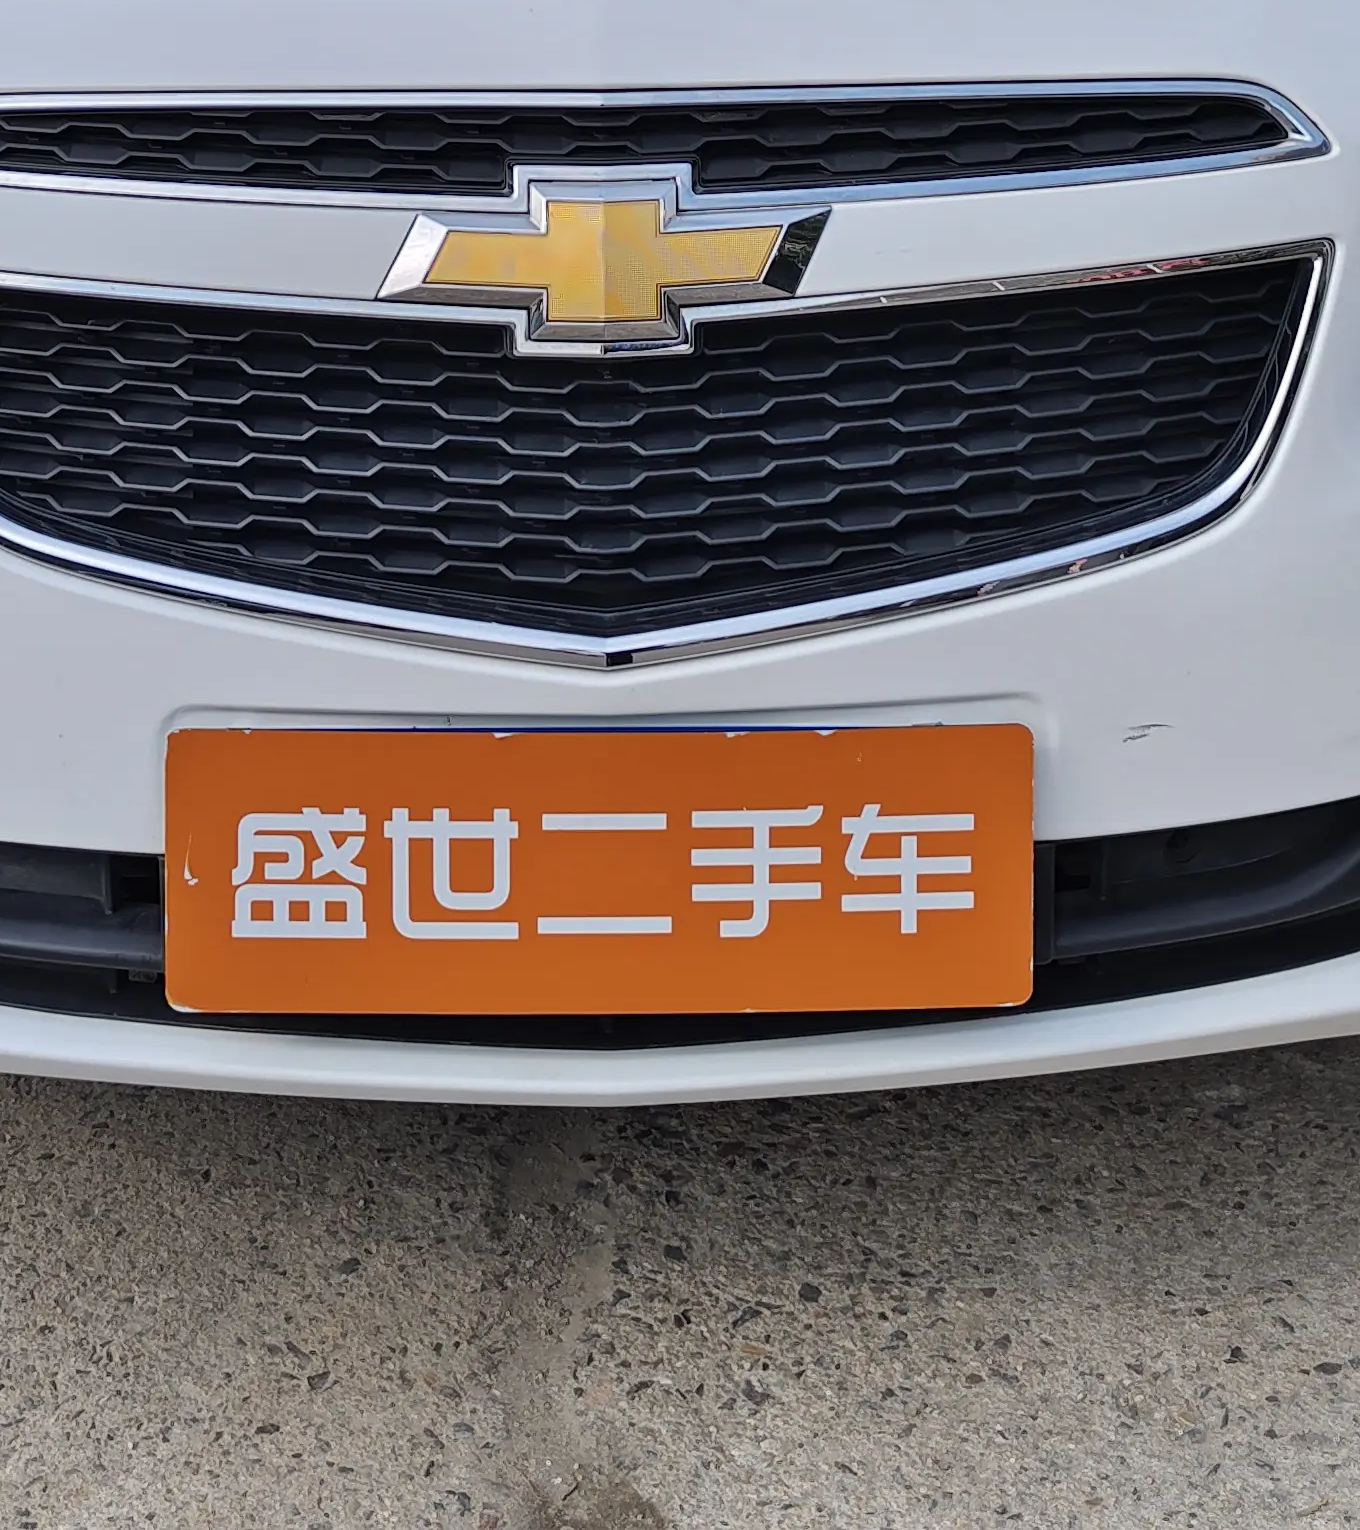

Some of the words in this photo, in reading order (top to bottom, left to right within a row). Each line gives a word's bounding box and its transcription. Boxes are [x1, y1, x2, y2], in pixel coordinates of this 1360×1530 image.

[230, 803, 976, 940] 盛世二手车
